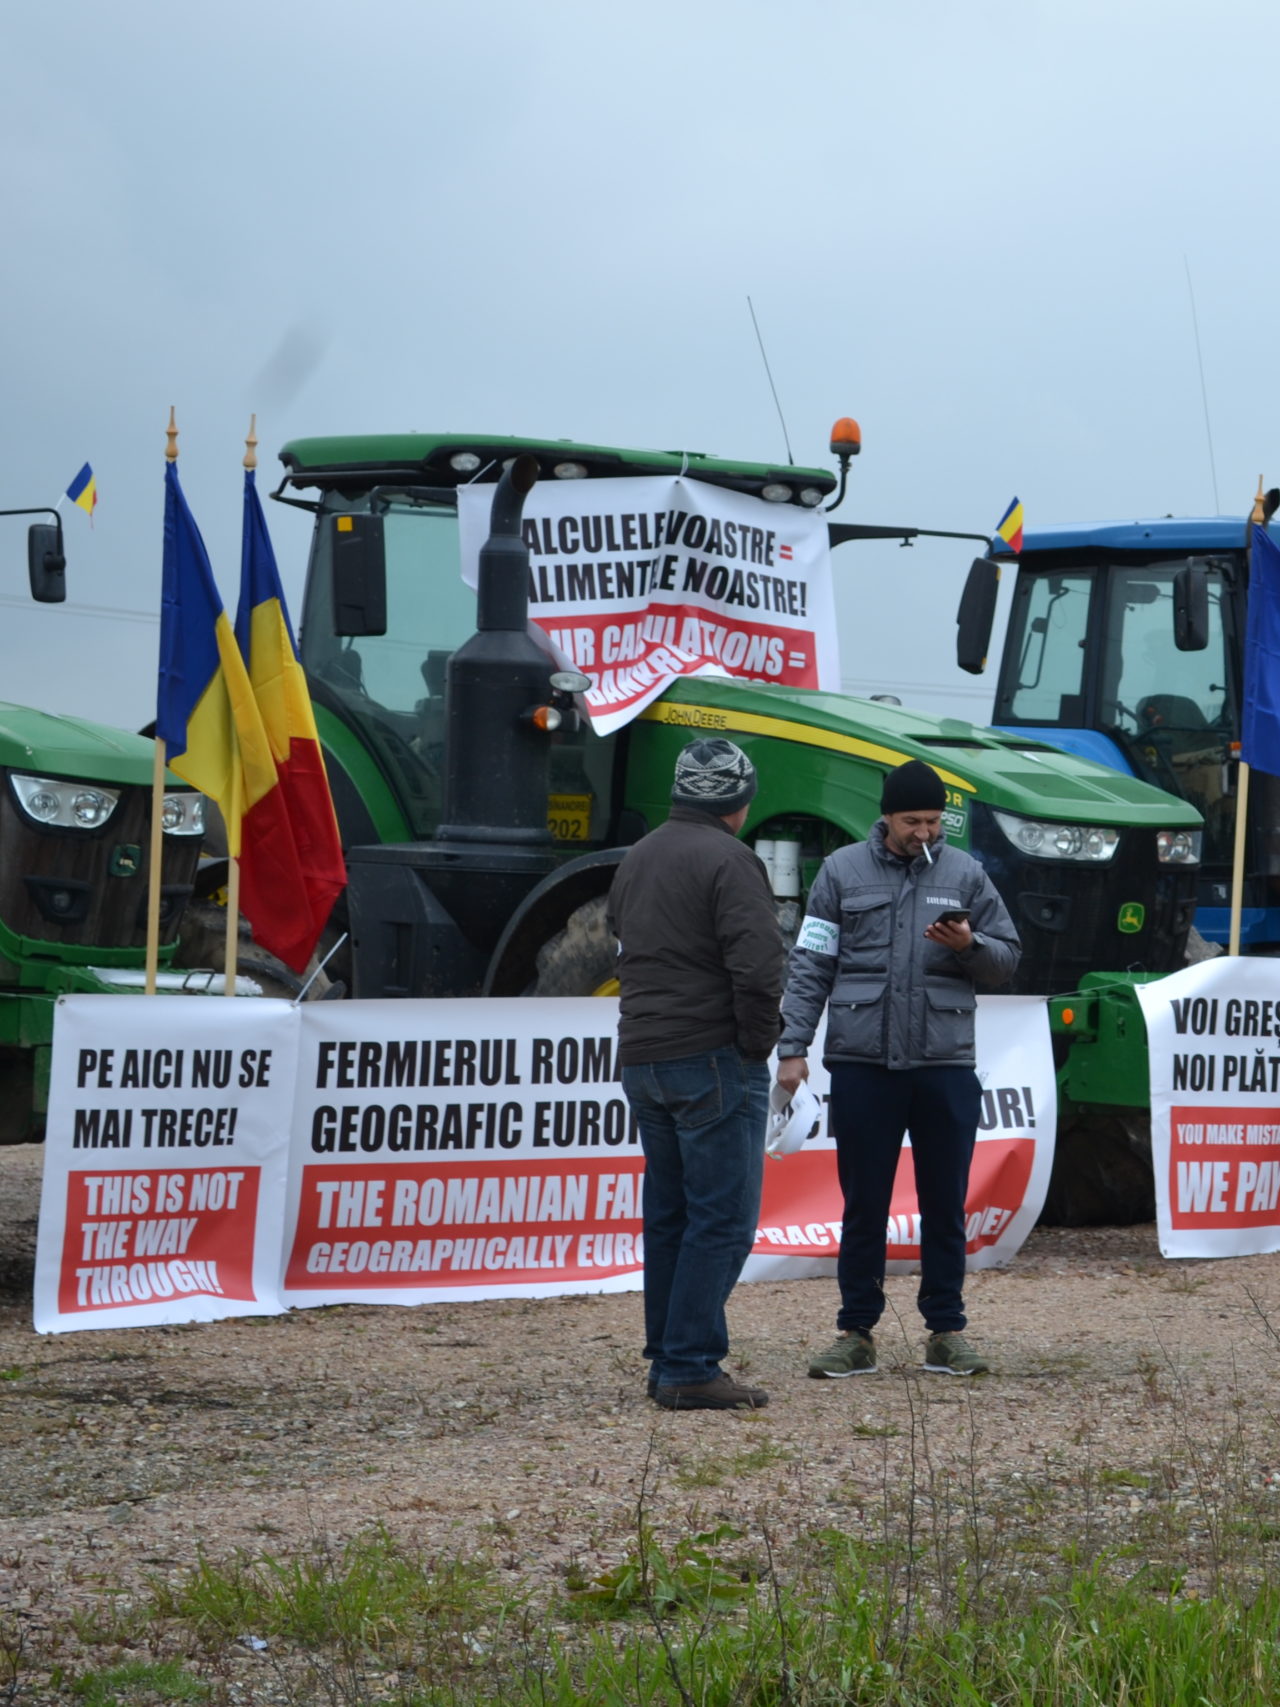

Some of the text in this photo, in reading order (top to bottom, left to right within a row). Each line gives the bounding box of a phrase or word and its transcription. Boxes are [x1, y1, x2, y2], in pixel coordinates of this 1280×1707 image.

[522, 512, 666, 556] ALCULELE
[664, 509, 776, 567] VOASTRE
[529, 555, 807, 616] ALIMENTE NOASTRE!
[601, 614, 784, 677] CAULATIONS
[1170, 998, 1217, 1035] VOI
[77, 1049, 272, 1089] PE AICI NU SE
[316, 1039, 520, 1088] FERMIERUL
[1173, 1054, 1215, 1091] NOI
[72, 1107, 238, 1149] MAI TRECE!
[311, 1103, 523, 1153] GEOGRAFIC
[1177, 1124, 1203, 1145] YOU
[1206, 1124, 1244, 1145] MAKE
[84, 1172, 244, 1216] THIS IS NOT
[316, 1180, 385, 1229] THE
[391, 1175, 588, 1226] ROMANIAN
[1177, 1161, 1230, 1213] WE
[81, 1218, 197, 1261] THE WAY
[306, 1235, 574, 1273] GEOGRAPHICALLY
[75, 1260, 223, 1306] THROUGH!
